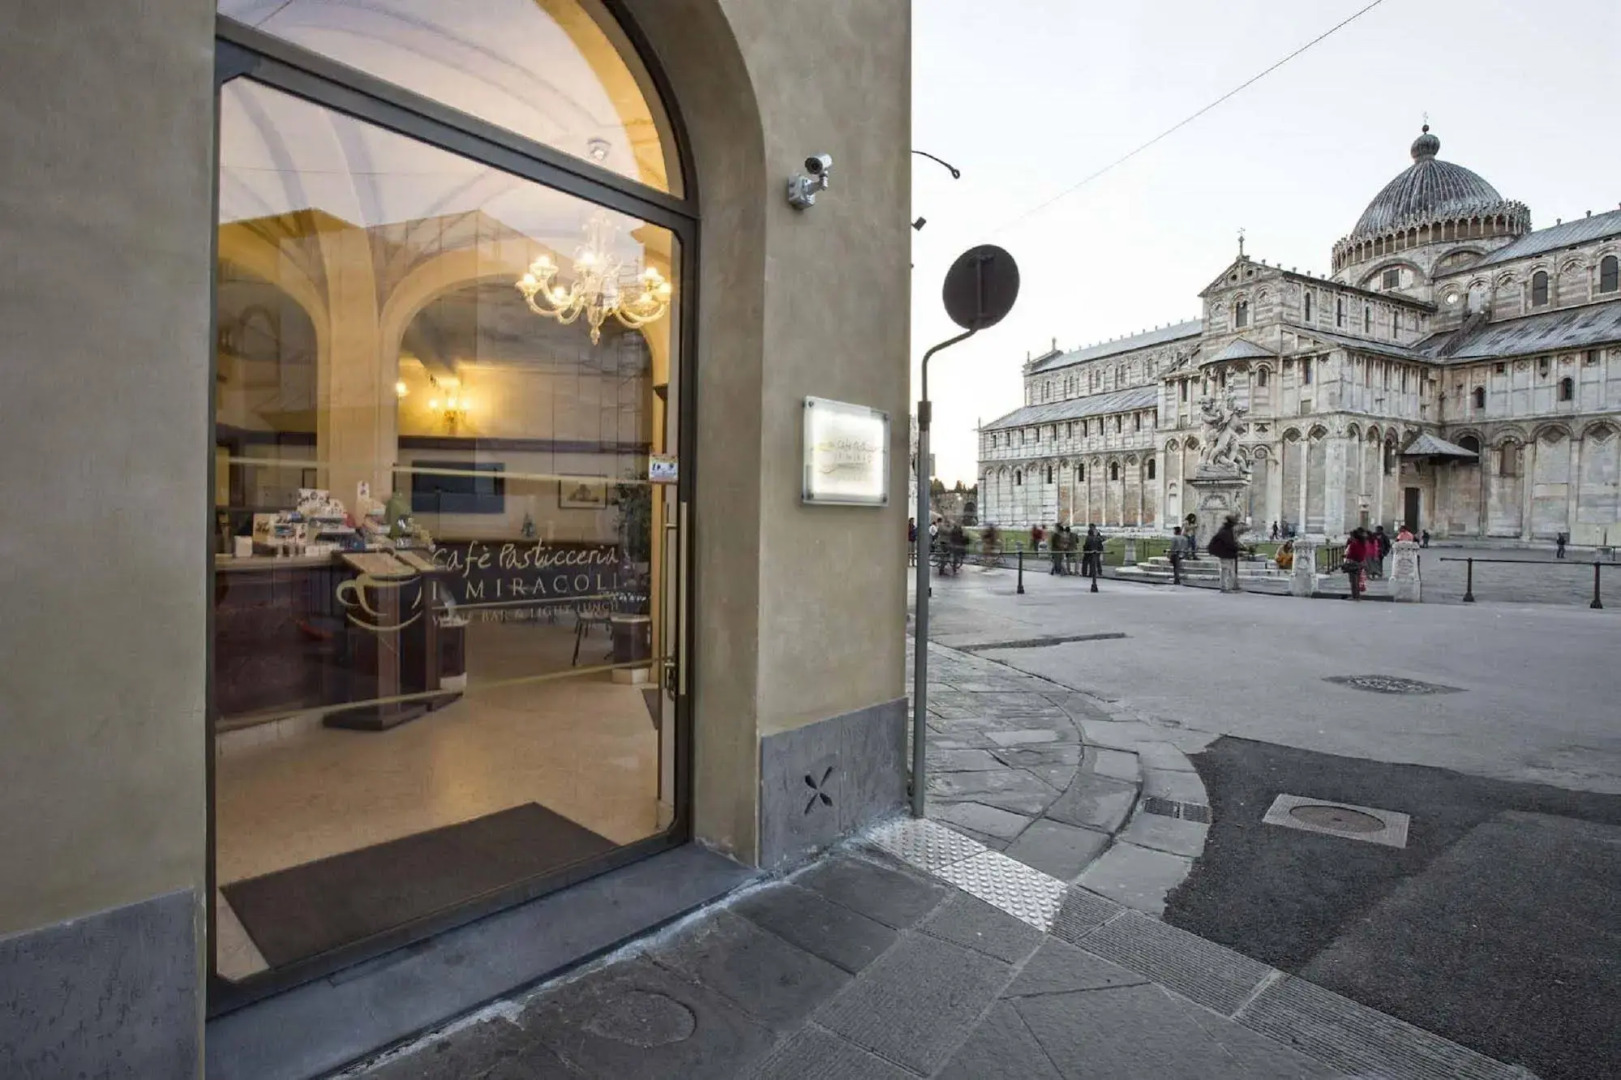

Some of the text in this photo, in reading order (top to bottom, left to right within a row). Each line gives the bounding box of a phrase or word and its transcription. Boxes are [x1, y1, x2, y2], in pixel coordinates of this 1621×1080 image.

[499, 537, 620, 570] Pasticceria
[431, 573, 619, 600] I MIRACOLI
